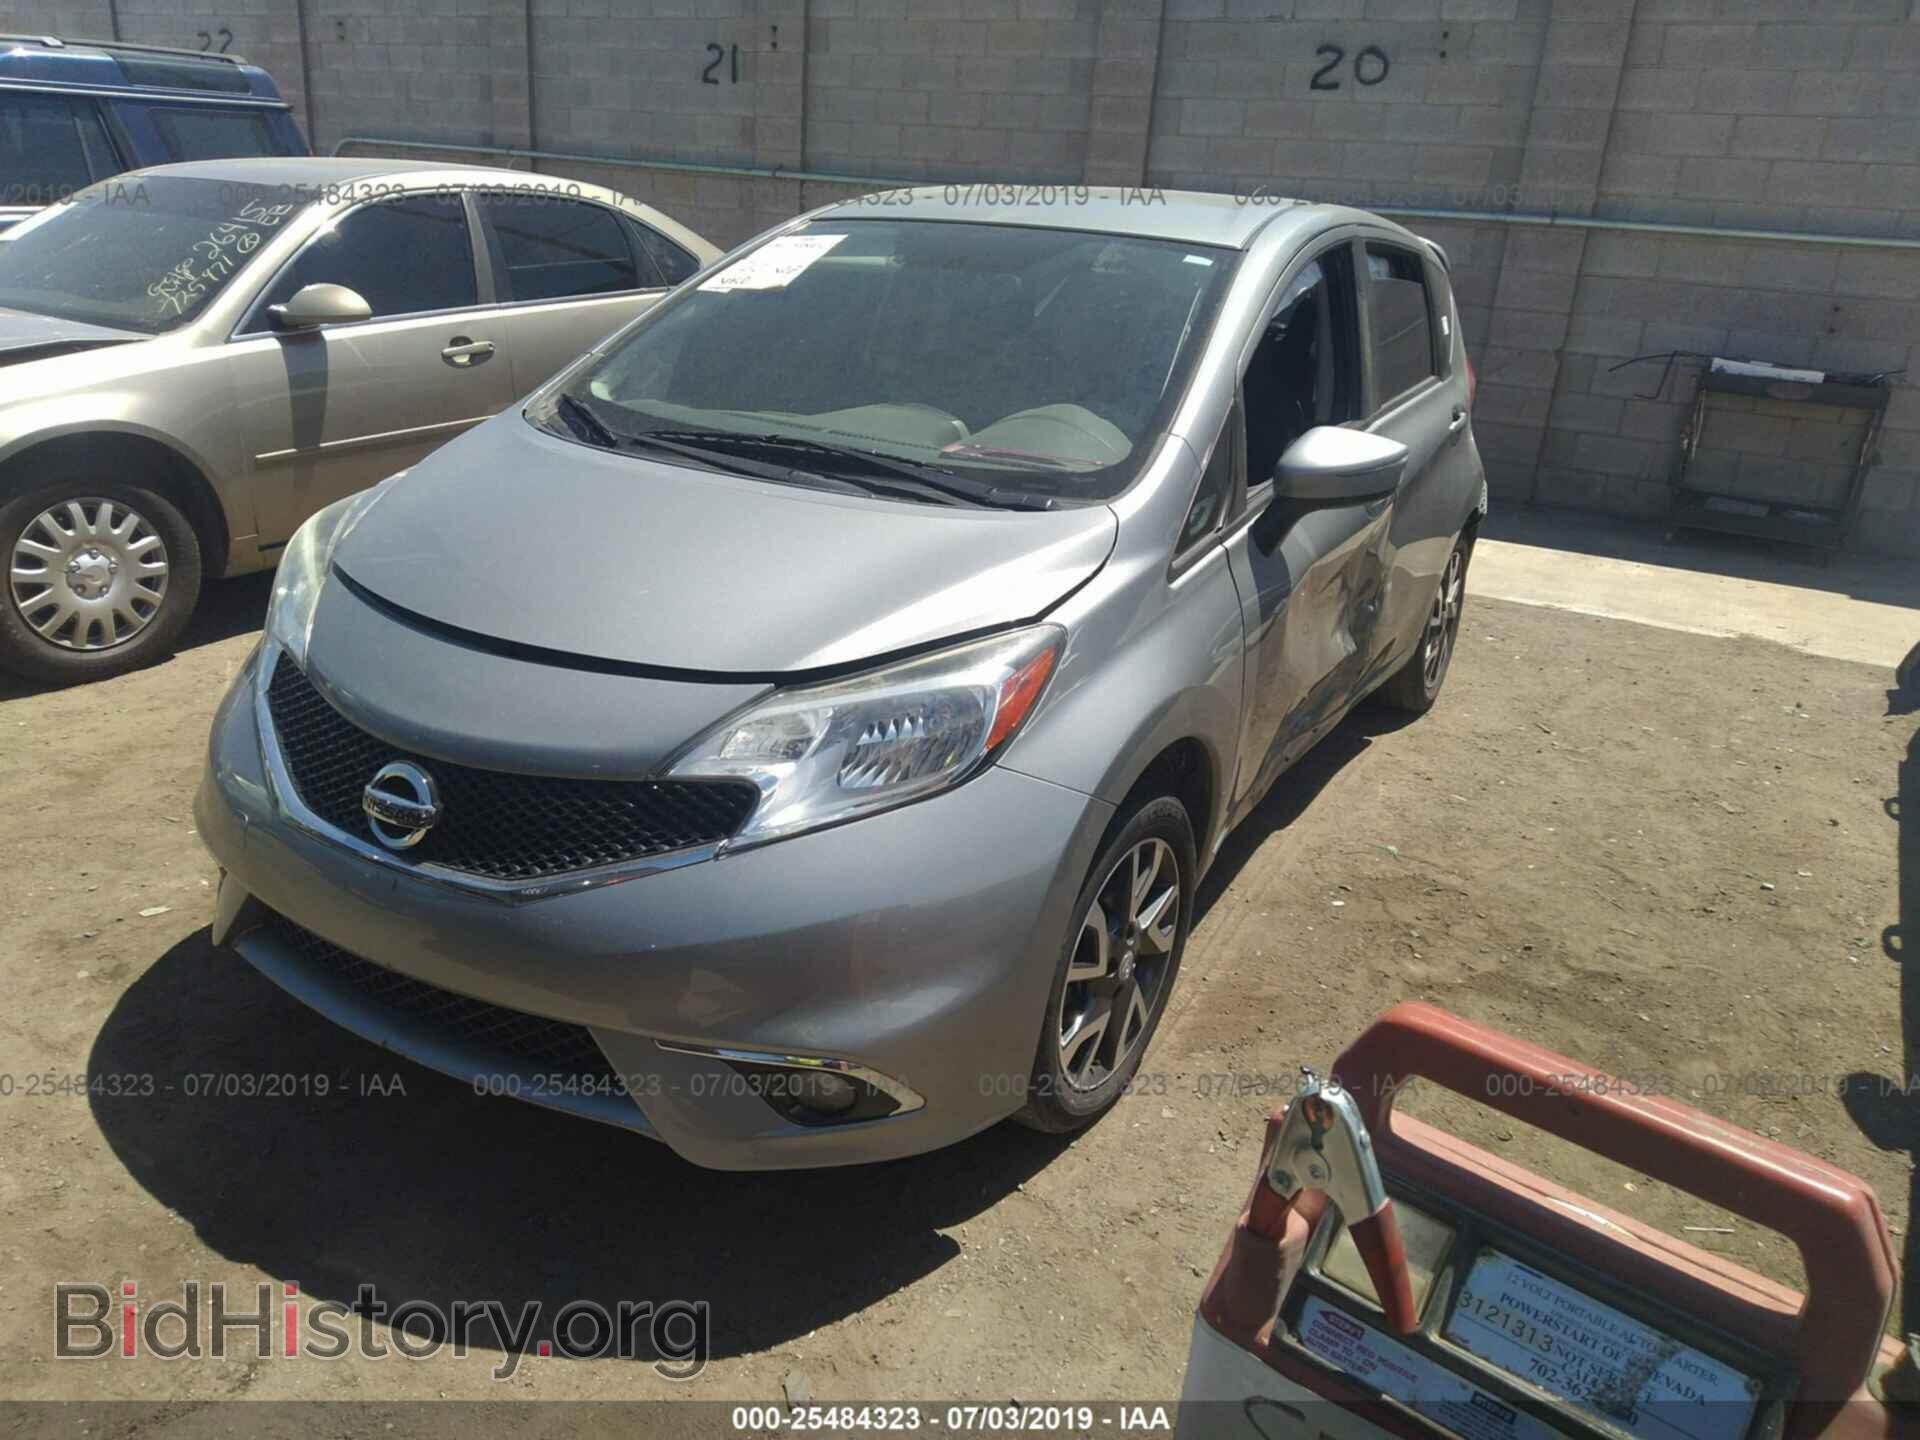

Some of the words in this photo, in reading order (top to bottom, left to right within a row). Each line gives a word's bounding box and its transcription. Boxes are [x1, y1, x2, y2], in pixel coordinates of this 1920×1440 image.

[703, 43, 738, 84] 21
[1310, 45, 1389, 90] 20
[1458, 1290, 1553, 1353] 3121313
[1499, 1292, 1600, 1351] POWERSTART
[1602, 1343, 1624, 1361] OF
[1521, 1280, 1552, 1301] VOLT
[1554, 1295, 1617, 1333] PORTABLE
[1617, 1329, 1657, 1352] AUTO
[1555, 1344, 1586, 1368] NOT
